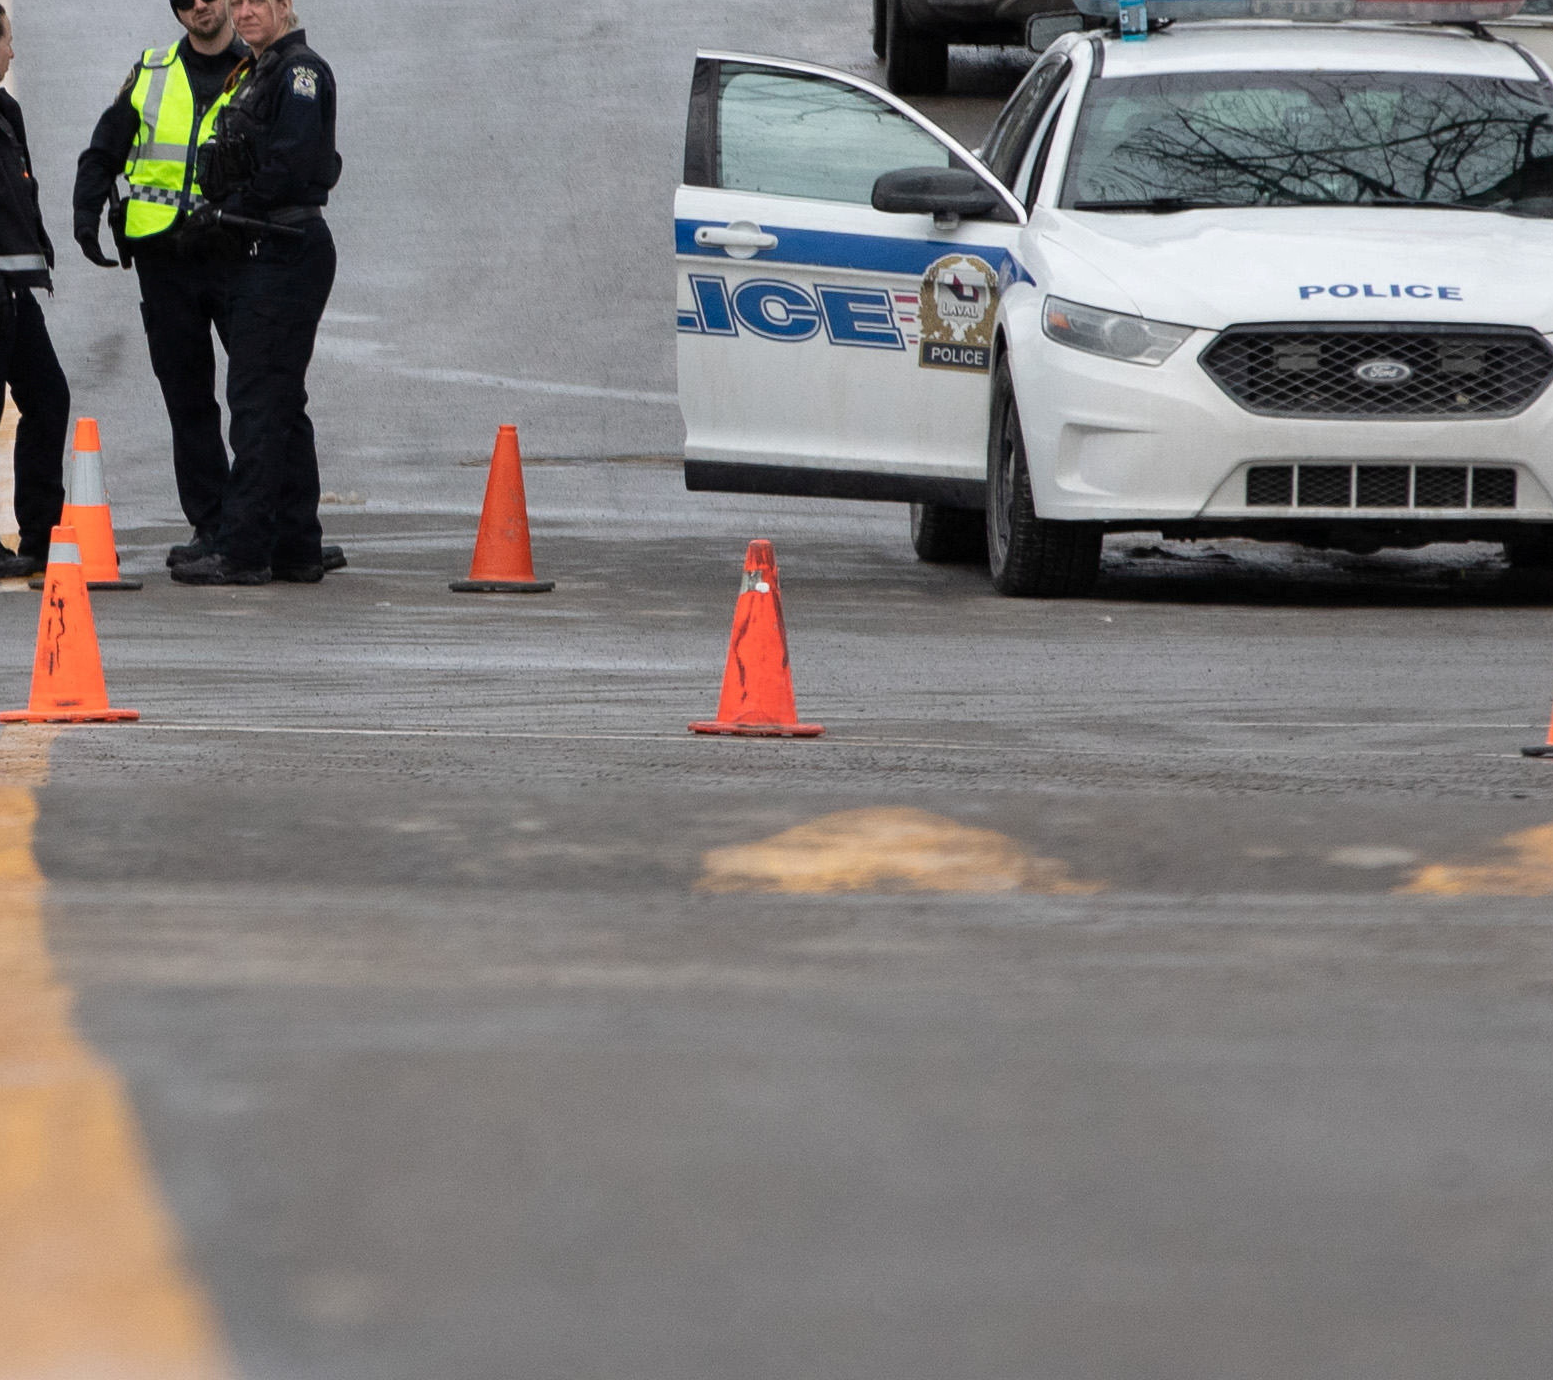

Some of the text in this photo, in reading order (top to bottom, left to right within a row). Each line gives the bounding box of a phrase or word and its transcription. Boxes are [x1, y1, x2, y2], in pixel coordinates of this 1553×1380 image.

[1298, 283, 1463, 302] POLICE
[940, 302, 980, 319] LAVAL
[931, 346, 984, 366] POLICE
